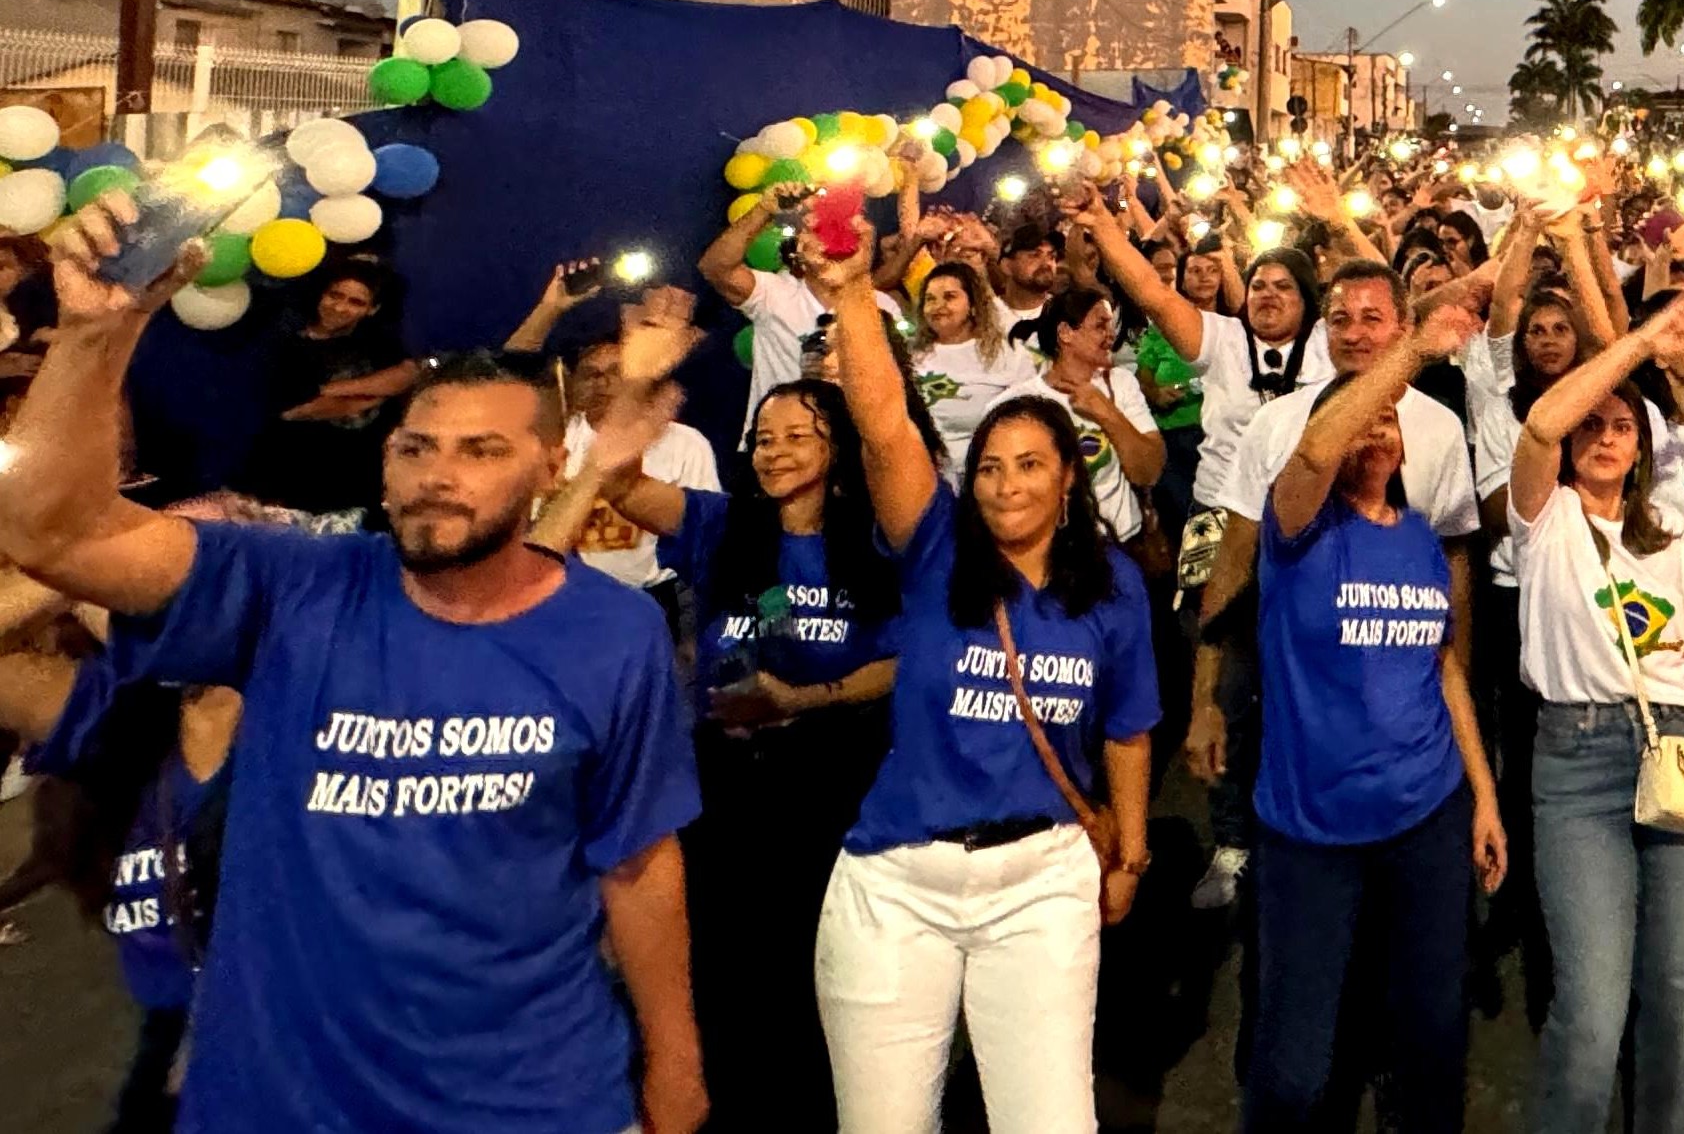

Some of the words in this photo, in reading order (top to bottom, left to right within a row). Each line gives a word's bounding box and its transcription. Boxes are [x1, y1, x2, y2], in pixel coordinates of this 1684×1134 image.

[1340, 618, 1384, 646] MAIS
[956, 645, 1027, 680] JUNTS
[316, 713, 434, 759] JUNTOS
[439, 716, 555, 756] SOMOS
[307, 772, 390, 816] MAIS
[393, 771, 534, 817] FORTES!
